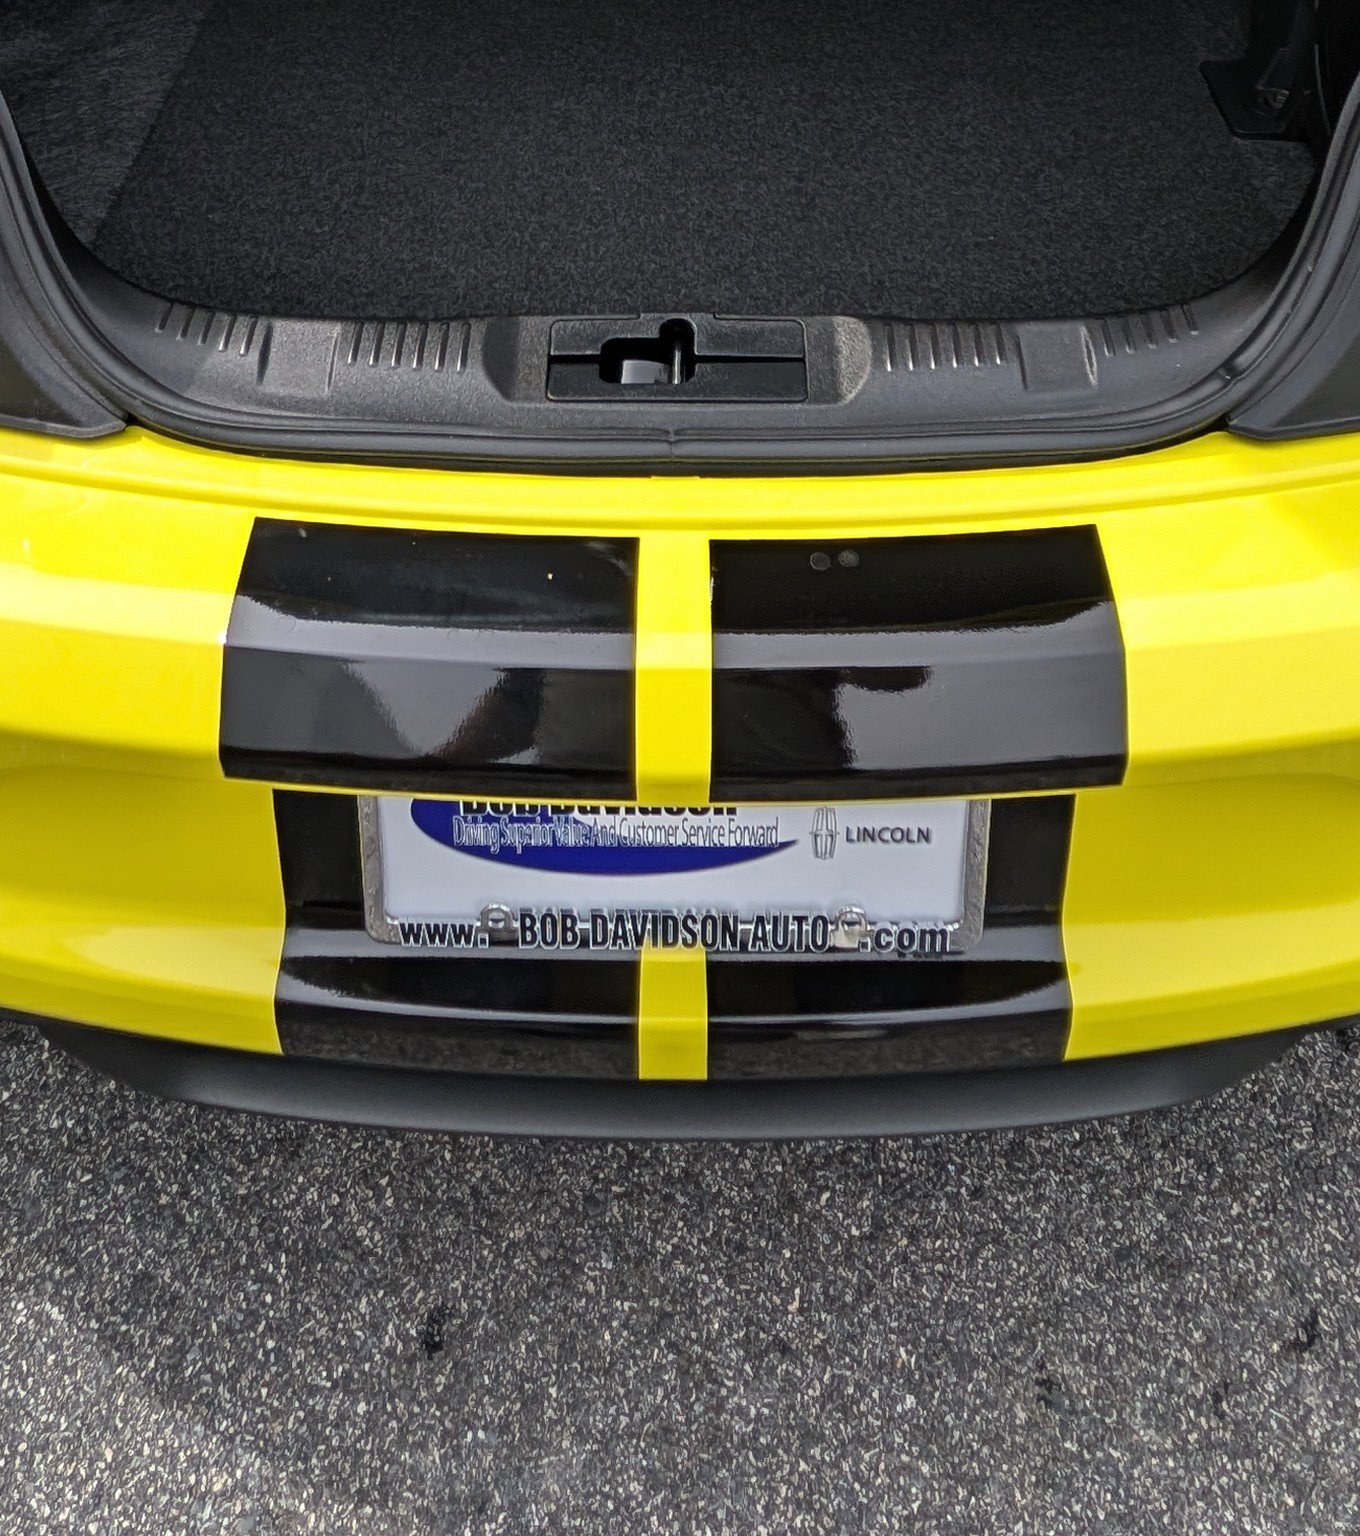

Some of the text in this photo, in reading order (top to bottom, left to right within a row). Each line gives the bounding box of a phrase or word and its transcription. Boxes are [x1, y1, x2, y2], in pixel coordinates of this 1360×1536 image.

[452, 814, 779, 854] Driving Superior Value And Customer Service Forward
[844, 825, 932, 844] LINCOLN
[518, 910, 581, 950] BOB
[589, 911, 739, 952] DAVIDSON
[748, 912, 831, 952] AUTO
